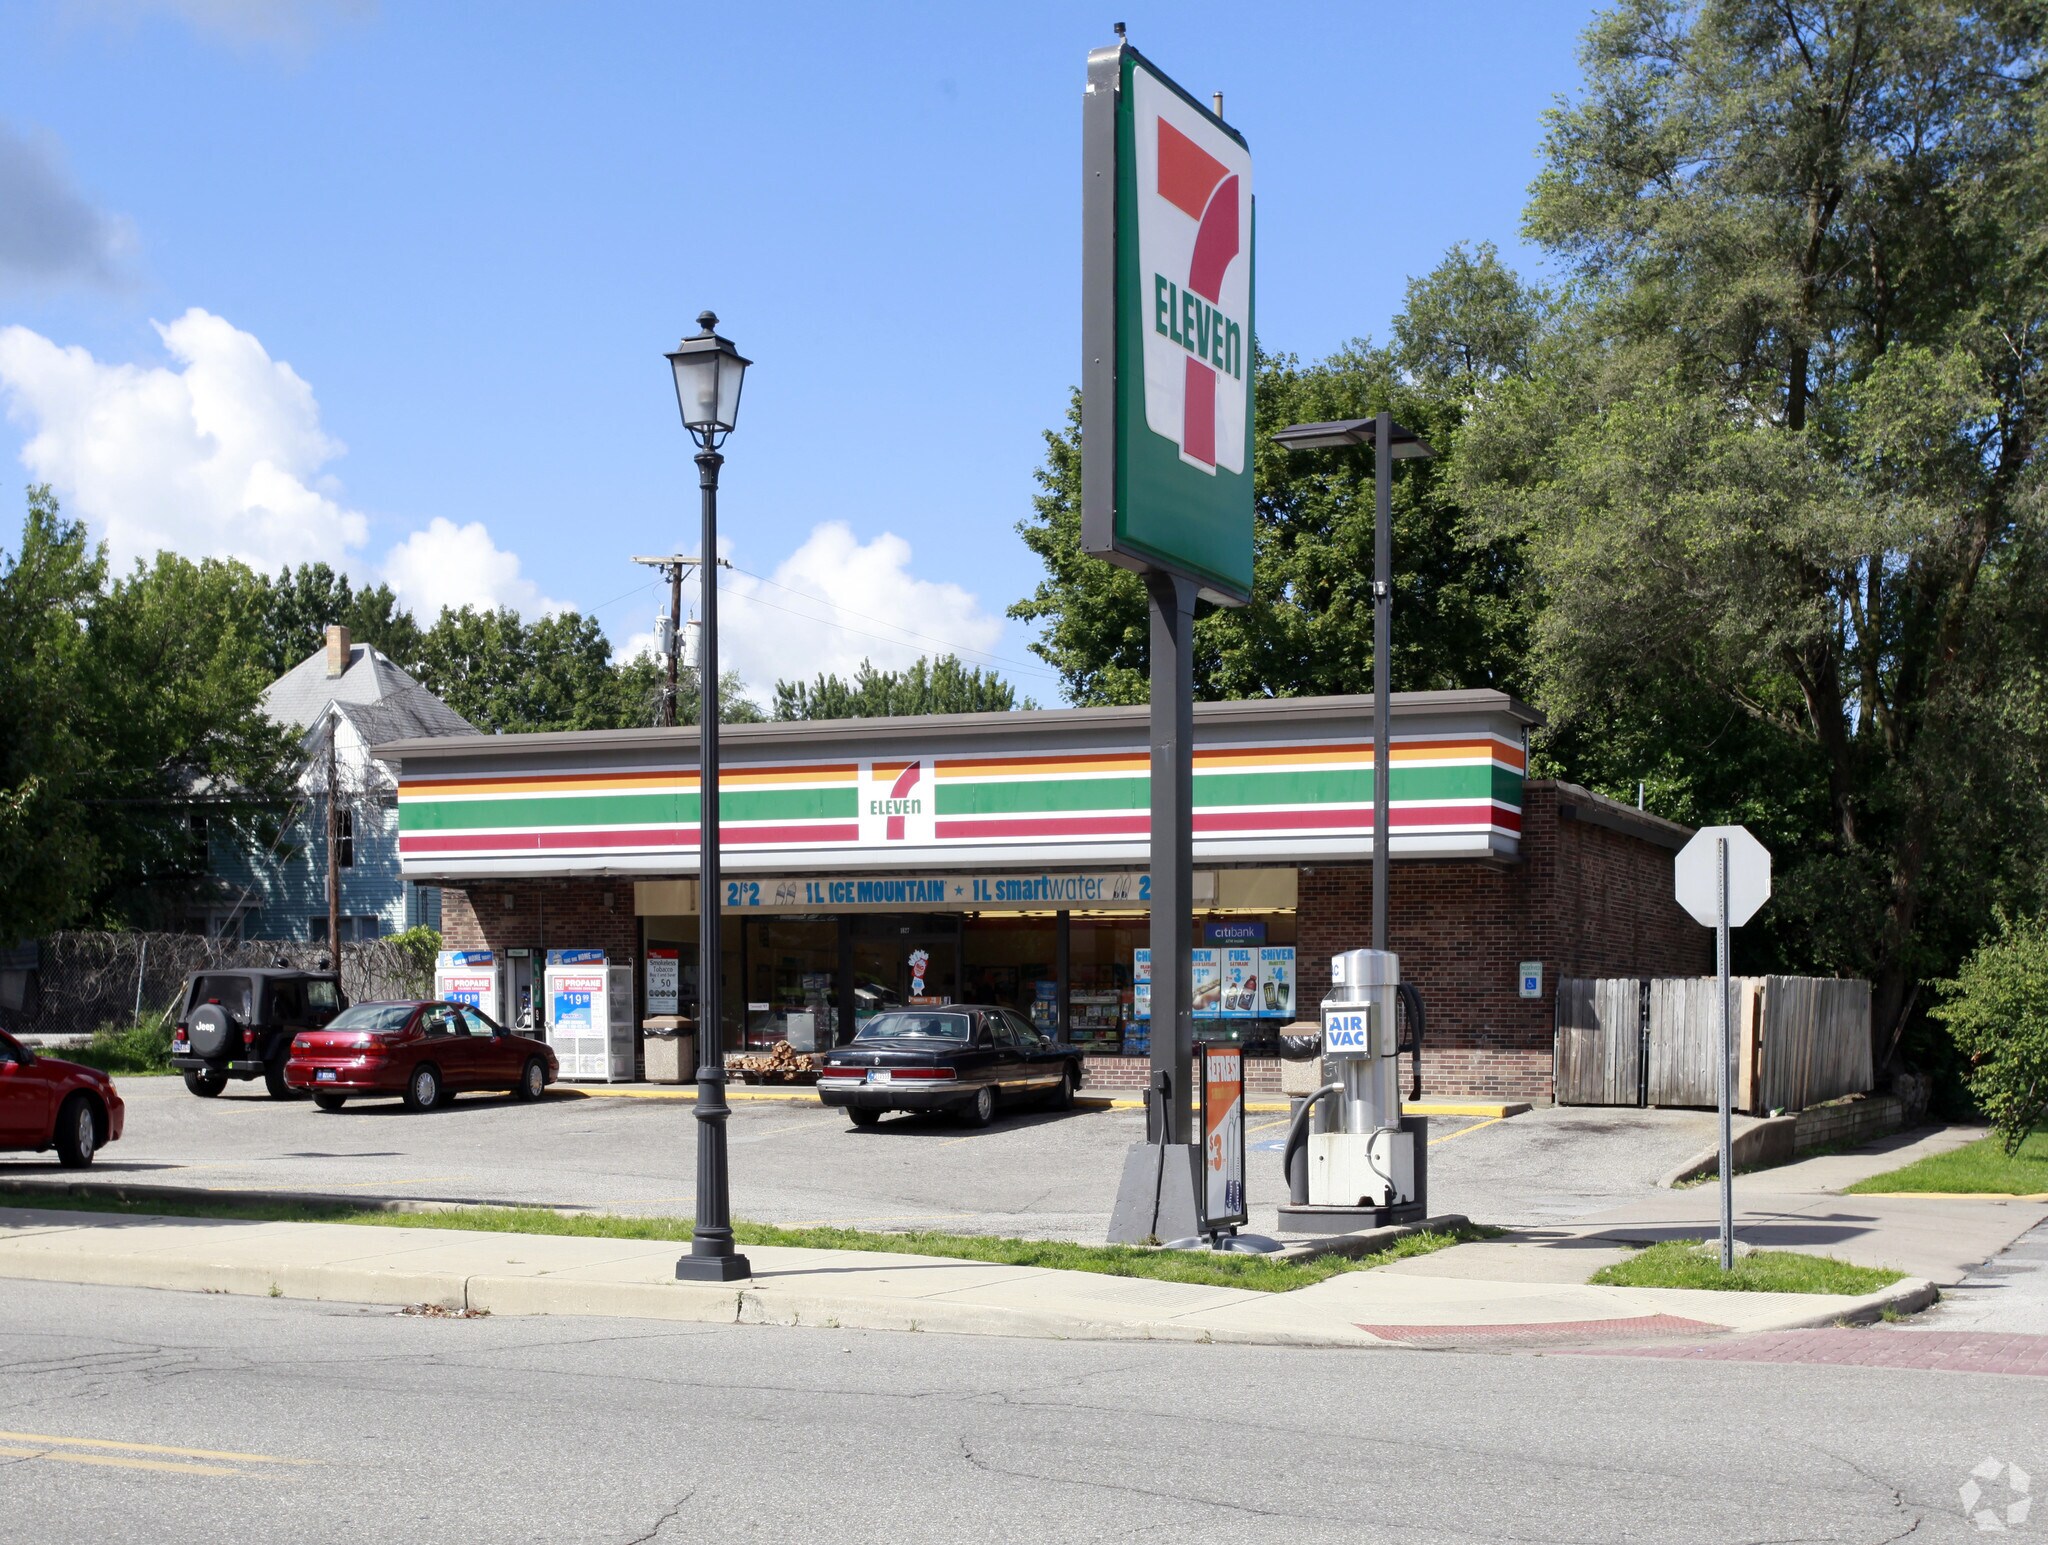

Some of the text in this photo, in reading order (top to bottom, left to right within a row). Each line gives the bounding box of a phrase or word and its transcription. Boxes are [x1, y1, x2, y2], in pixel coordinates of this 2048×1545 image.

[828, 881, 855, 903] ICE
[857, 880, 945, 903] MOUNTAIN
[995, 875, 1104, 900] smartwater
[1215, 927, 1254, 938] citibank
[1228, 949, 1251, 961] FUEL
[454, 979, 489, 987] PROPANE
[565, 979, 601, 987] PROPANE
[660, 978, 671, 988] 50
[196, 1021, 215, 1033] Jeep
[1329, 1016, 1362, 1032] AIR
[1329, 1031, 1364, 1046] VAC
